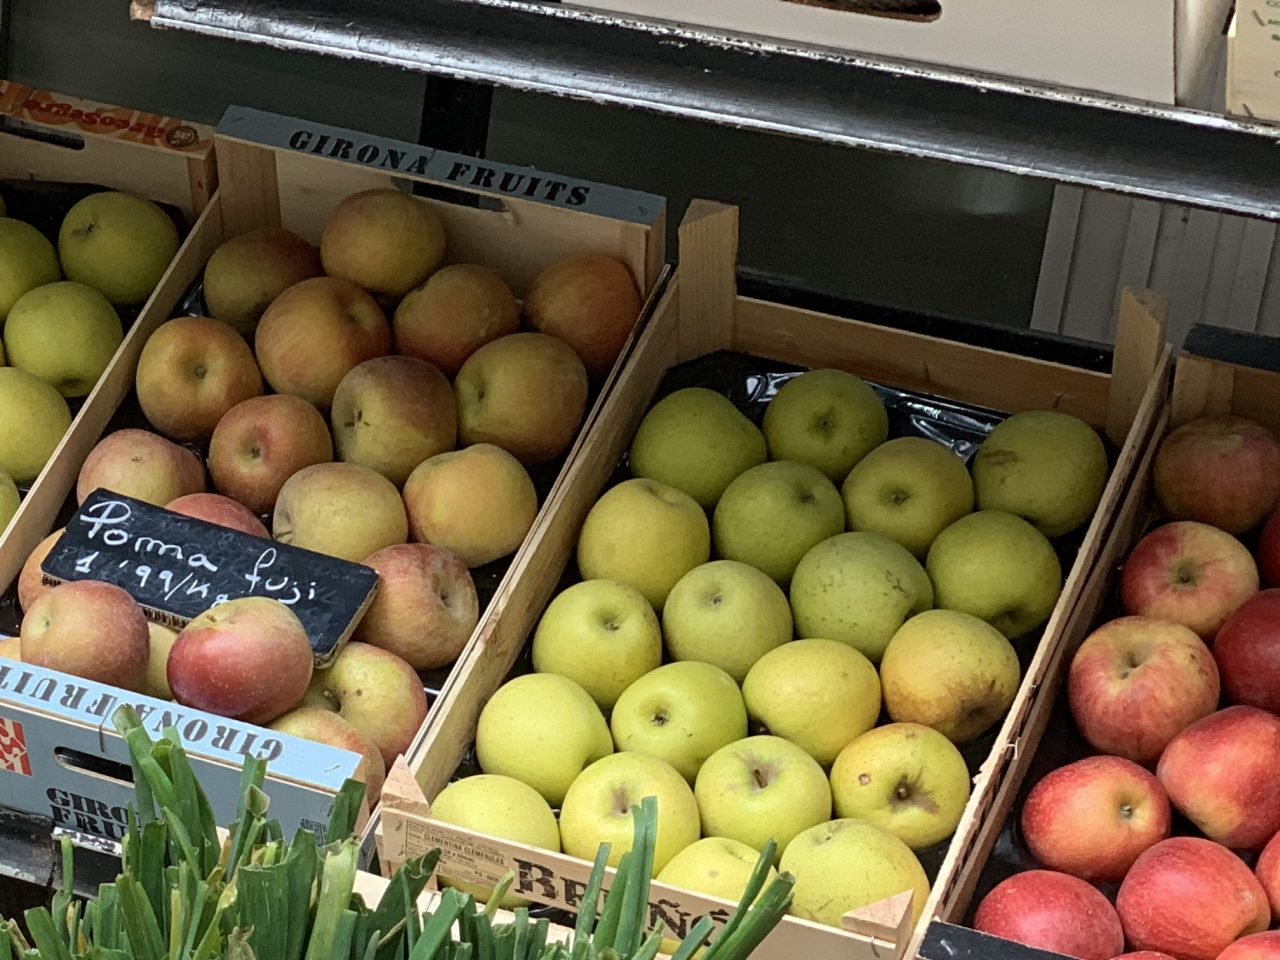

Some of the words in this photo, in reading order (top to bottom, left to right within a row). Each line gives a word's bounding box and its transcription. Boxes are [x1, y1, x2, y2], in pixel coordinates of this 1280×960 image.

[24, 99, 166, 138] arcoSegre
[289, 129, 428, 176] GIRONA
[446, 162, 592, 207] FRUITS
[80, 501, 218, 572] Poma
[245, 547, 316, 605] fuji
